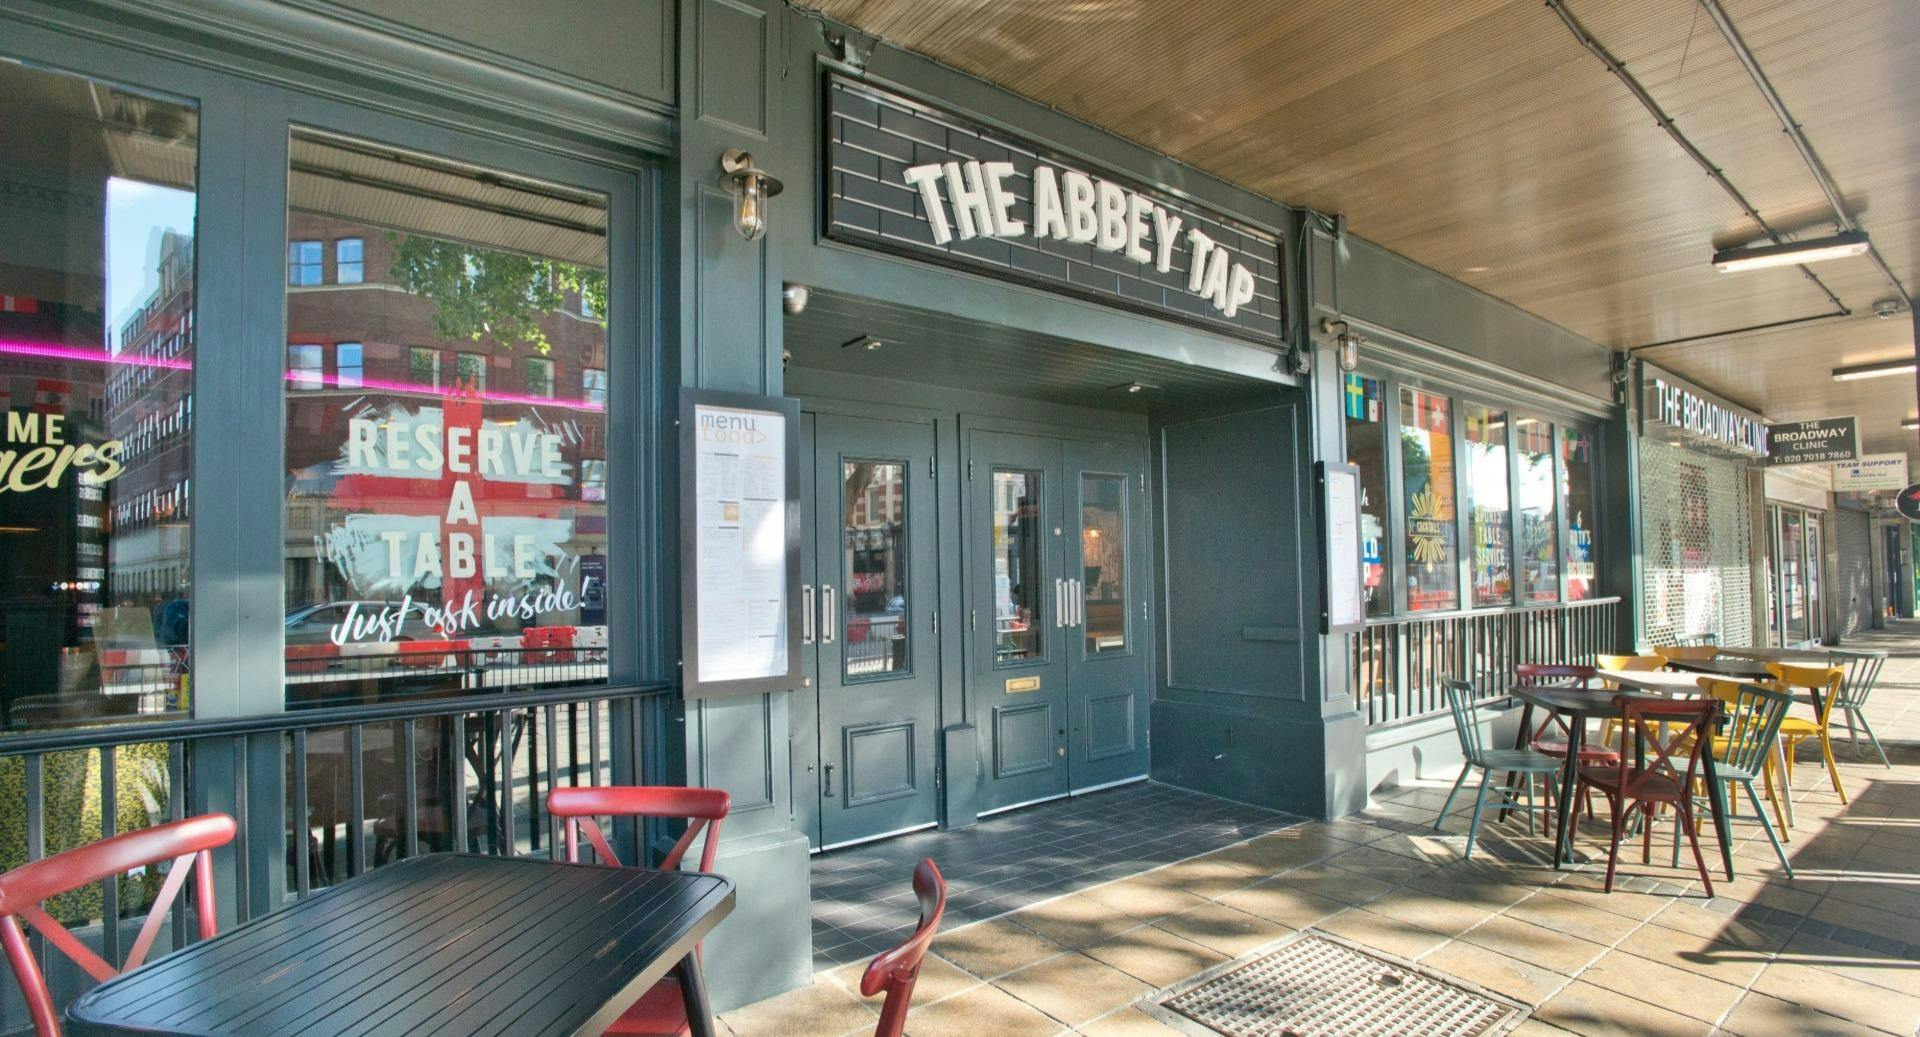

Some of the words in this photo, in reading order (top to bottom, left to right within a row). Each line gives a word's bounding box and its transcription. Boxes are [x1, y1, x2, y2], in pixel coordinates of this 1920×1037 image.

[904, 161, 1025, 245] THE
[1033, 166, 1182, 273] ABBEY
[1187, 228, 1255, 318] TAP
[701, 414, 755, 433] menu
[1655, 378, 1682, 428] THE
[1683, 391, 1741, 447] BROADWAY
[1742, 416, 1770, 457] CLINIC
[1799, 421, 1820, 431] THE
[1774, 427, 1848, 443] BROADWAY
[349, 418, 563, 478] RESERVE
[1792, 440, 1829, 451] CLINIC
[1774, 456, 1783, 464] T:
[1784, 455, 1801, 463] 020
[1803, 453, 1826, 462] 7018
[1828, 450, 1851, 460] 7860
[1862, 459, 1903, 468] SUPPORT
[446, 480, 479, 525] A
[1416, 521, 1441, 533] COCKTAILS
[1478, 526, 1503, 545] TABLE
[380, 531, 537, 579] TABLE
[1475, 547, 1505, 567] SERVICE
[331, 594, 413, 645] Just
[424, 589, 481, 634] ask
[487, 575, 590, 621] inside!
